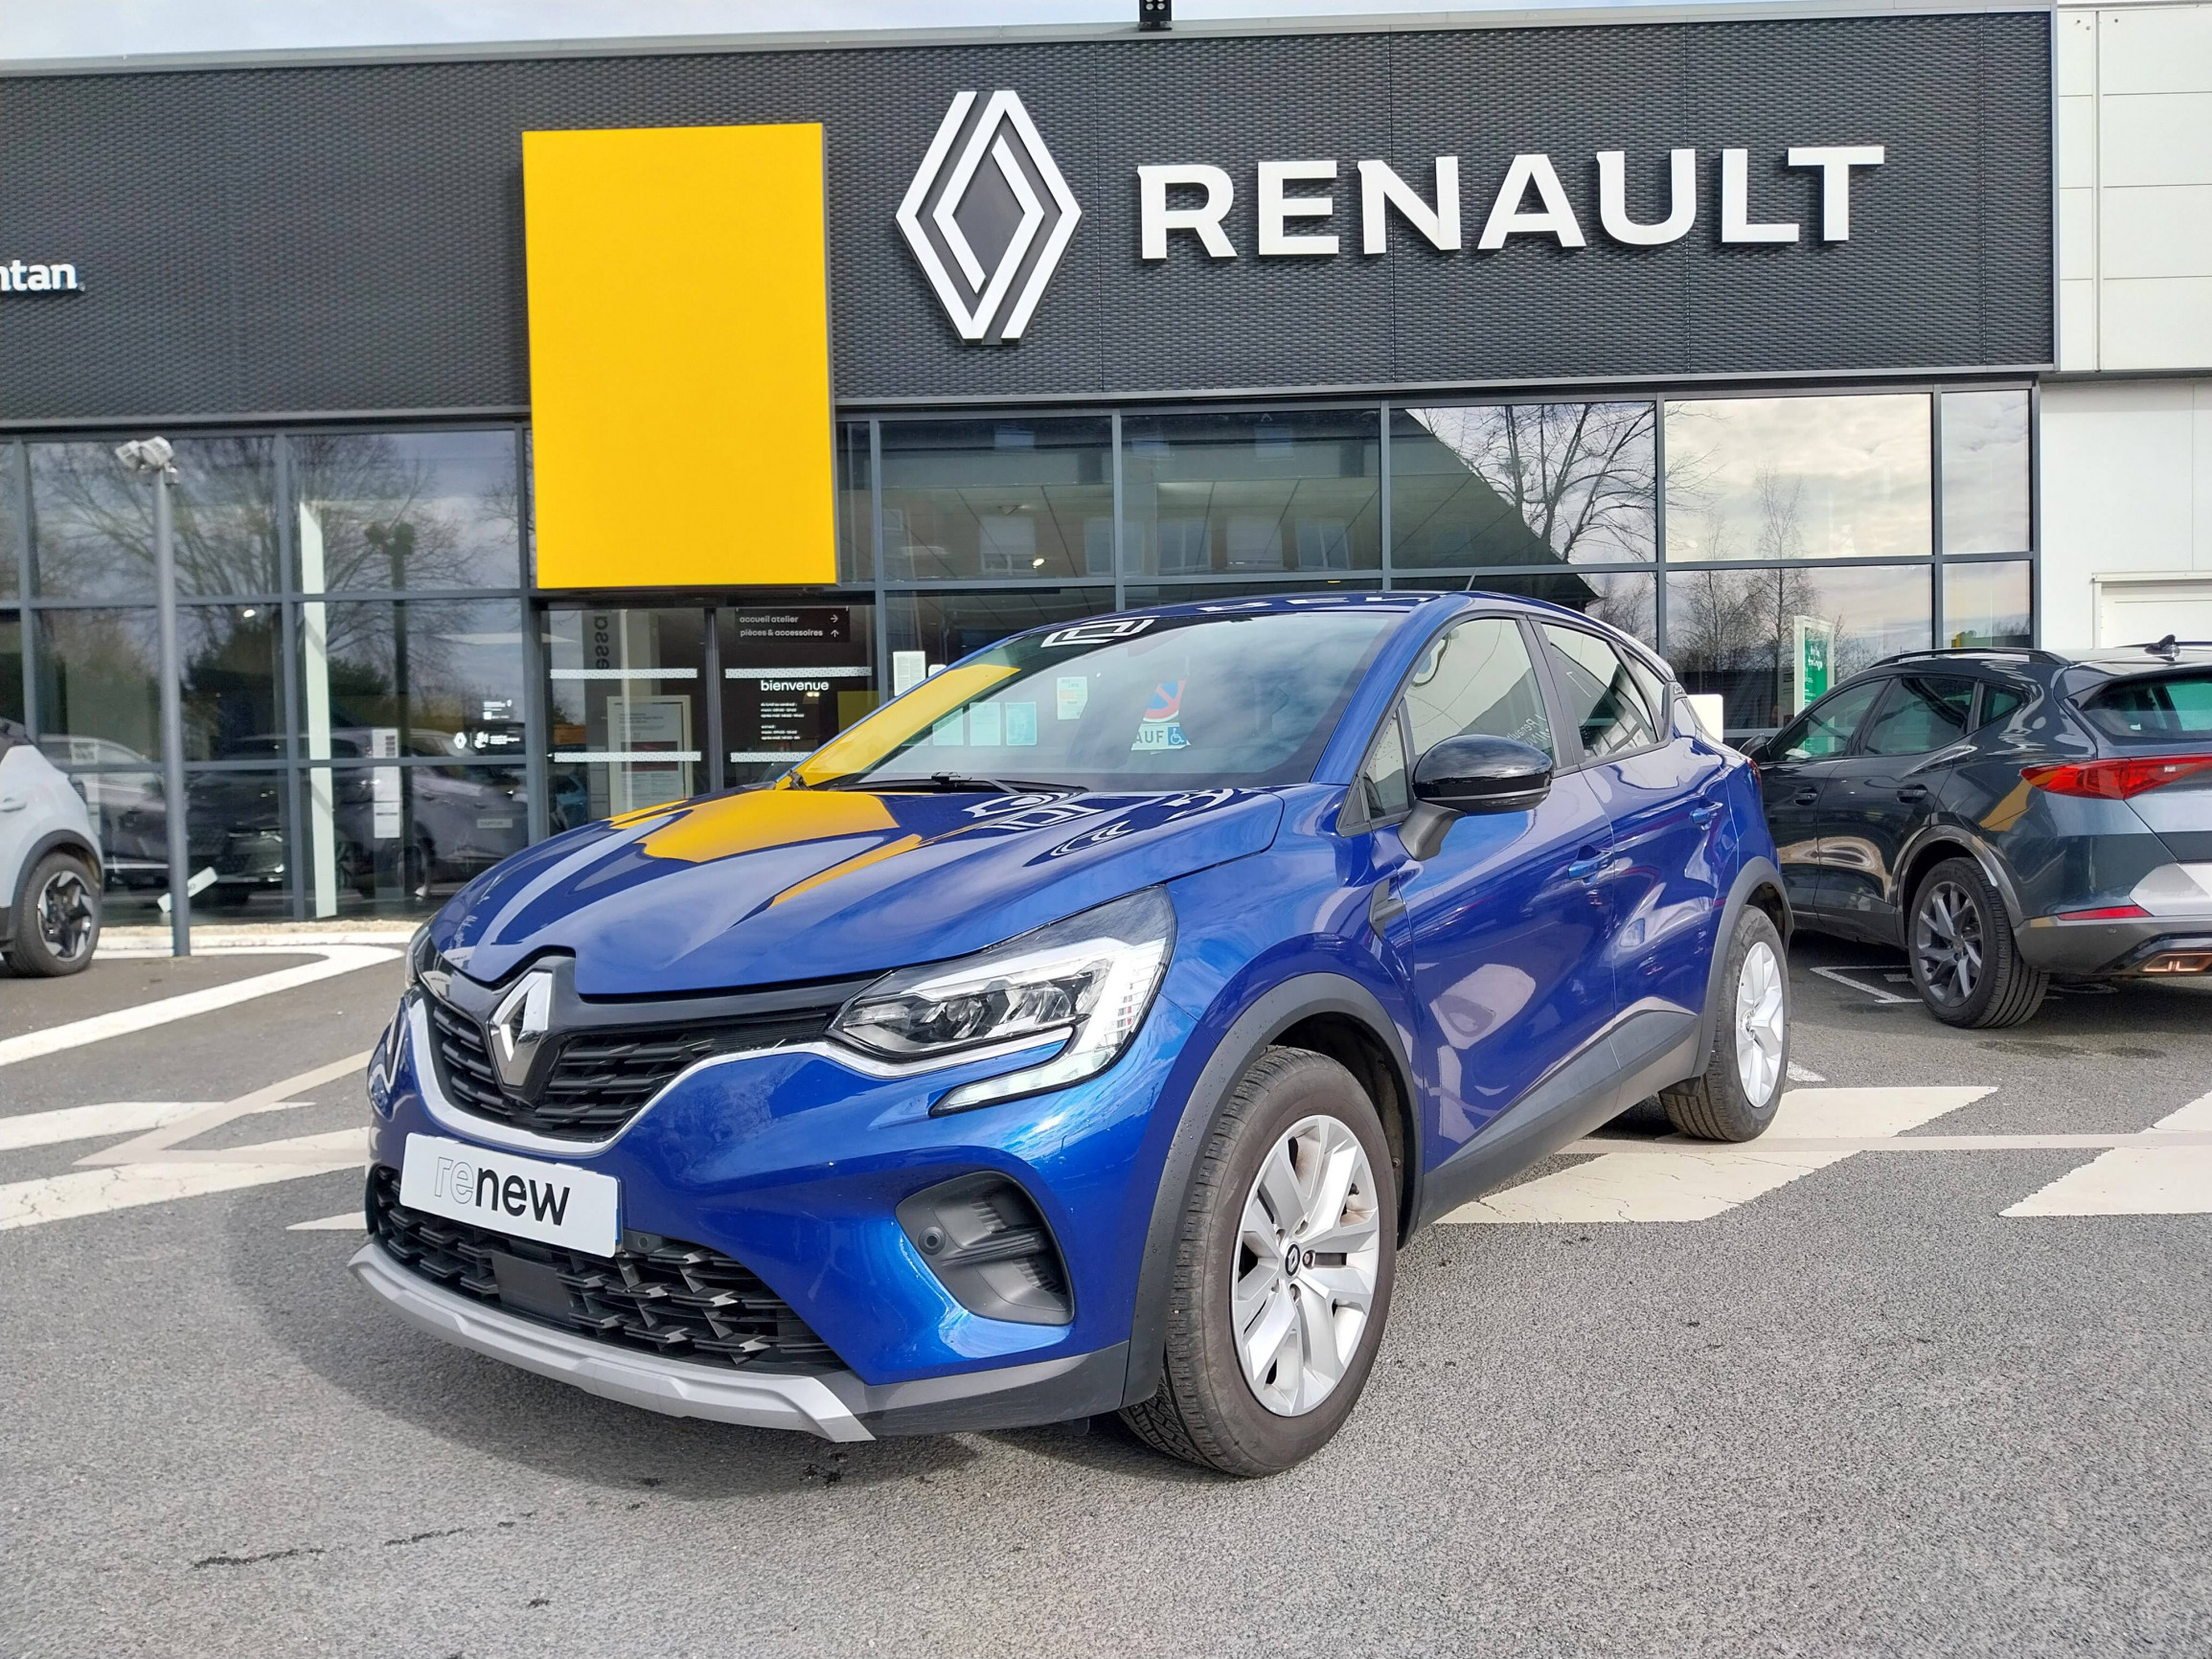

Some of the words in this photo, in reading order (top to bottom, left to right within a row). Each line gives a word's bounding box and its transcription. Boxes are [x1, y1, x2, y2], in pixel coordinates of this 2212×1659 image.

[1136, 145, 1885, 261] RENAULT
[739, 615, 770, 624] accueil
[770, 615, 799, 624] atelier
[740, 628, 766, 638] pièces
[767, 628, 774, 637] &
[774, 628, 824, 637] accessoires
[760, 679, 830, 692] bienvenue
[434, 1156, 571, 1227] renew
